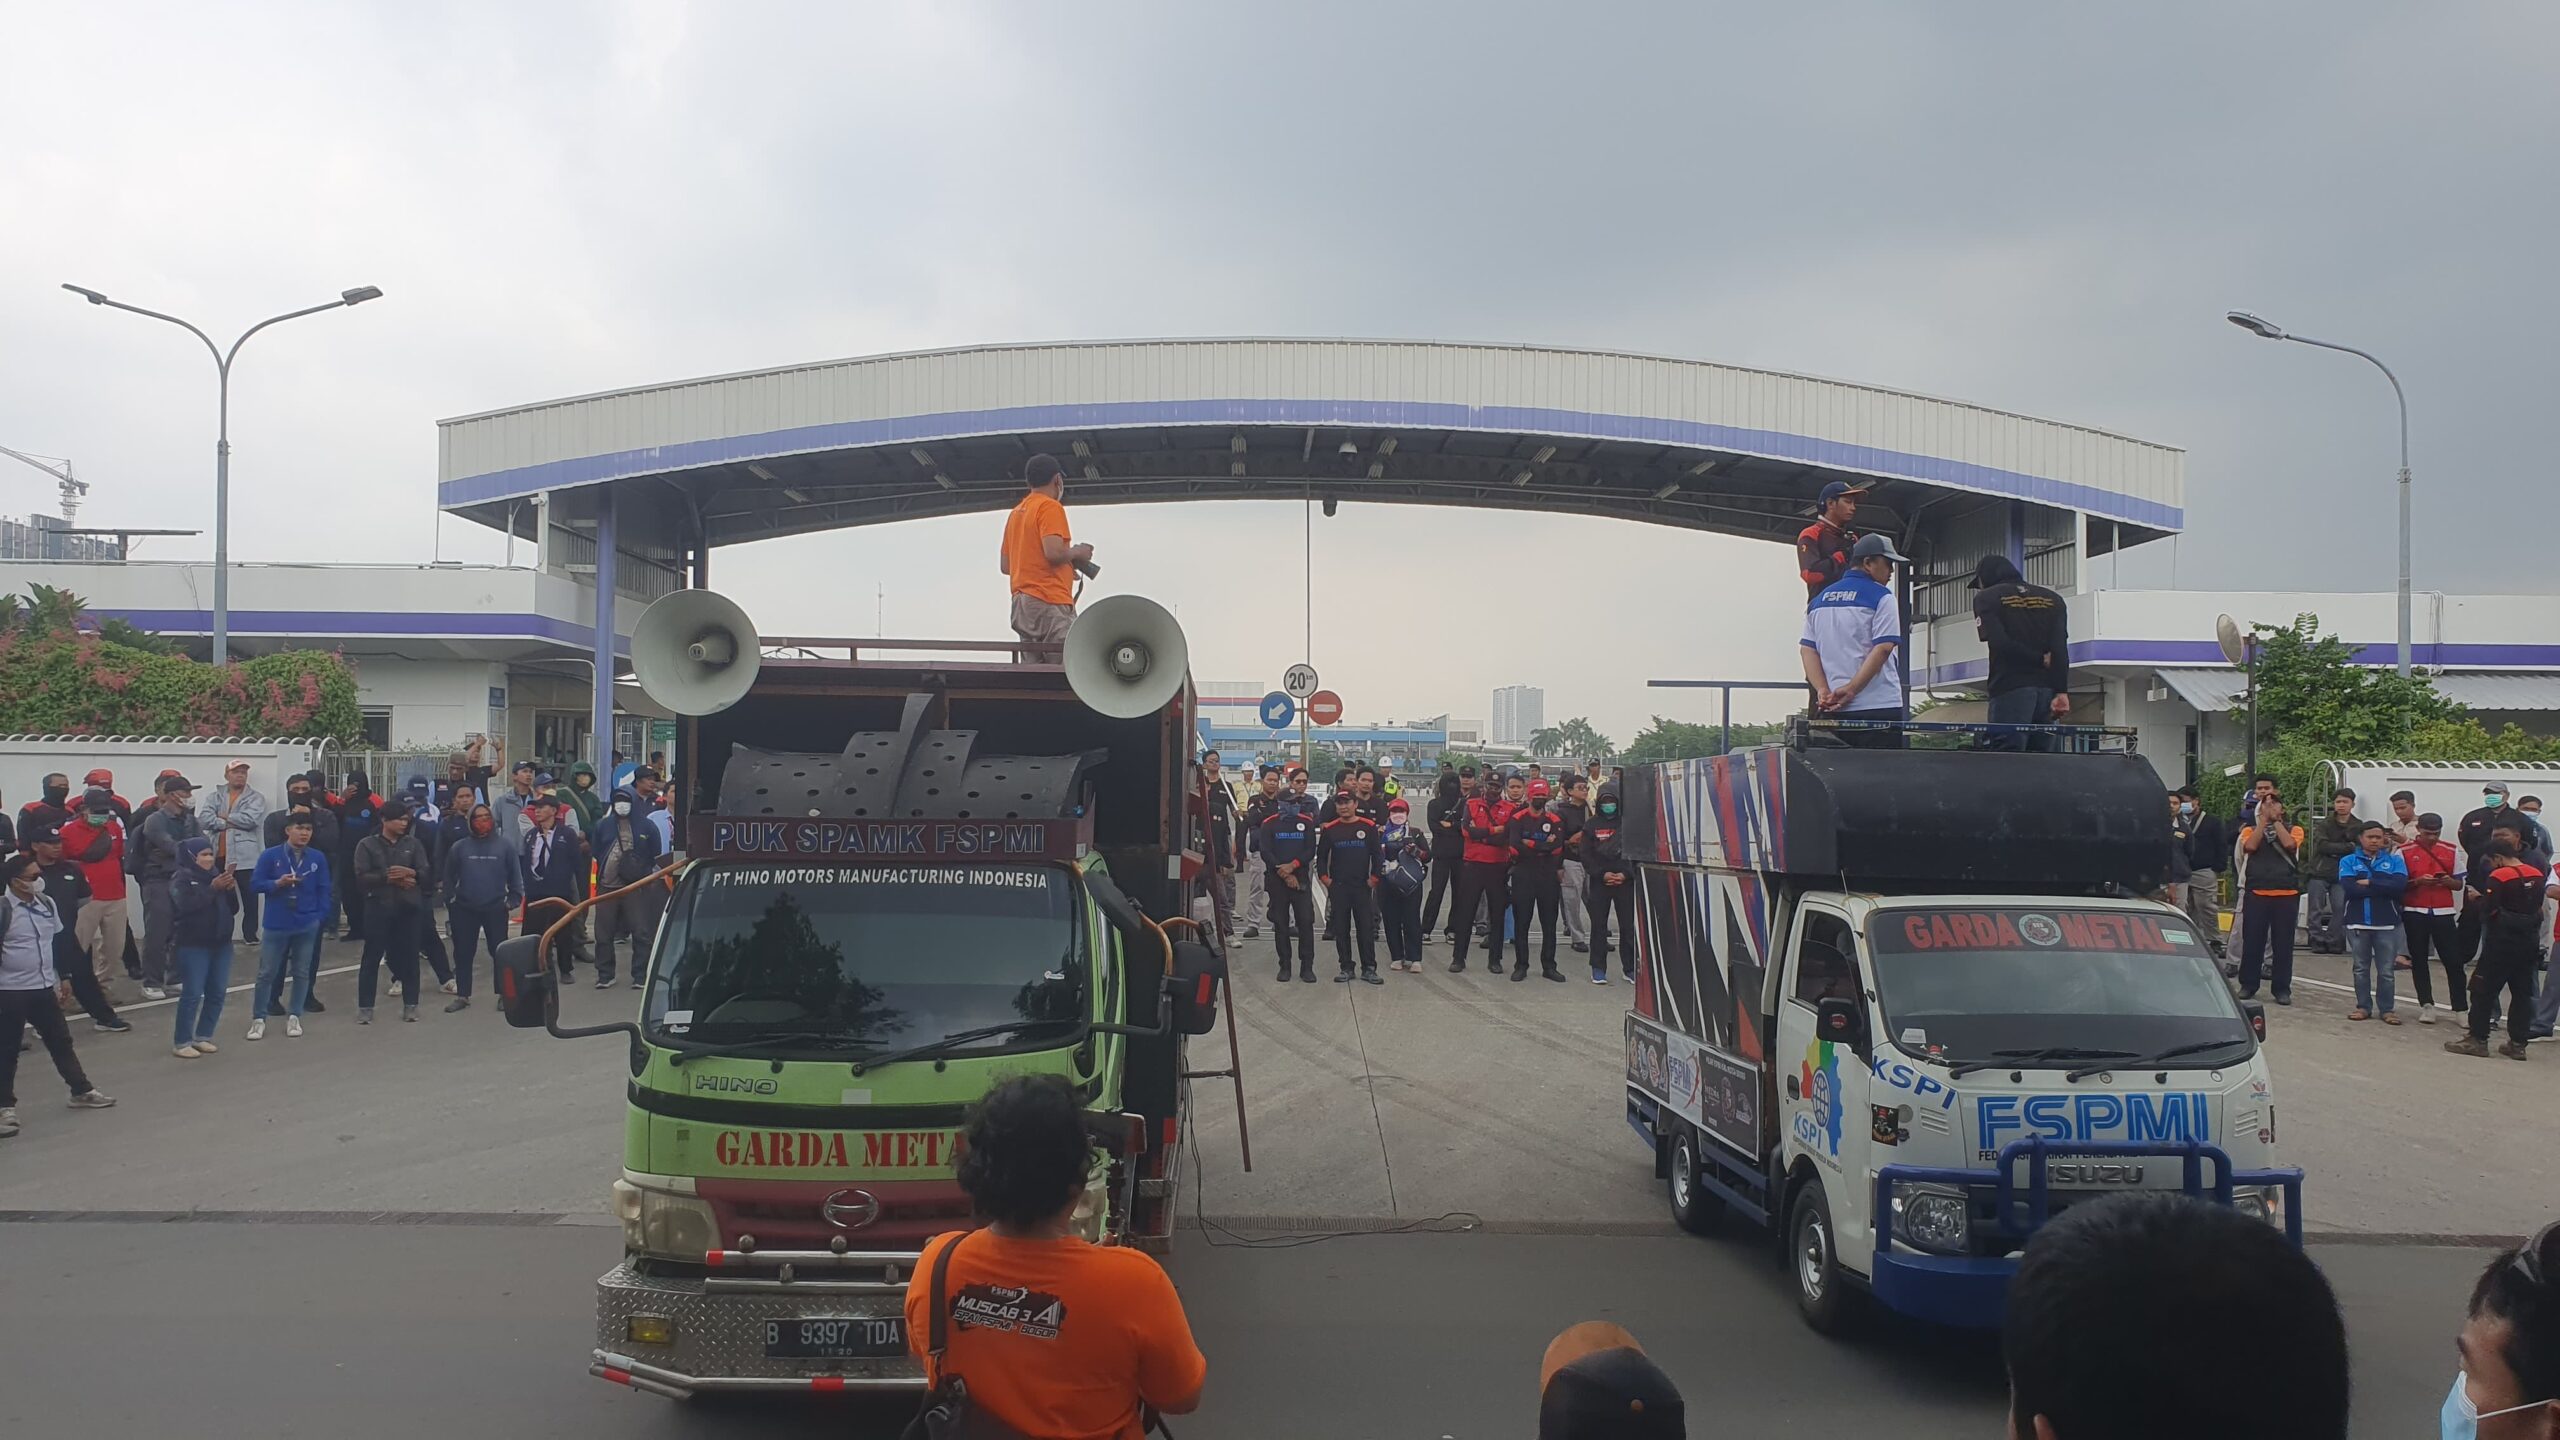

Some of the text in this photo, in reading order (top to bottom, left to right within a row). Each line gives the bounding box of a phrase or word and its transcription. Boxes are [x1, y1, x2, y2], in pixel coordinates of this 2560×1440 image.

[1822, 590, 1858, 602] FSPMI
[1289, 672, 1306, 690] 20
[713, 822, 1045, 854] PUK SPAMK FSPMI
[712, 868, 1048, 889] PT HINO MOTORS MANUFACTURING INDONESIA
[1904, 912, 2025, 949] GARDA
[2060, 913, 2177, 951] METAL
[695, 1074, 778, 1096] HINO
[1871, 1055, 1958, 1111] KSPI
[1793, 1111, 1823, 1150] KSPI
[1976, 1092, 2209, 1150] FSPMI
[716, 1131, 849, 1168] GARDA
[2047, 1164, 2144, 1184] ISUZU
[991, 1286, 1018, 1298] FSPMI
[957, 1295, 1020, 1320] MUSCAB
[1020, 1309, 1032, 1322] 3
[766, 1319, 900, 1345] B 9397 TDA
[1020, 1323, 1058, 1339] BOGOR
